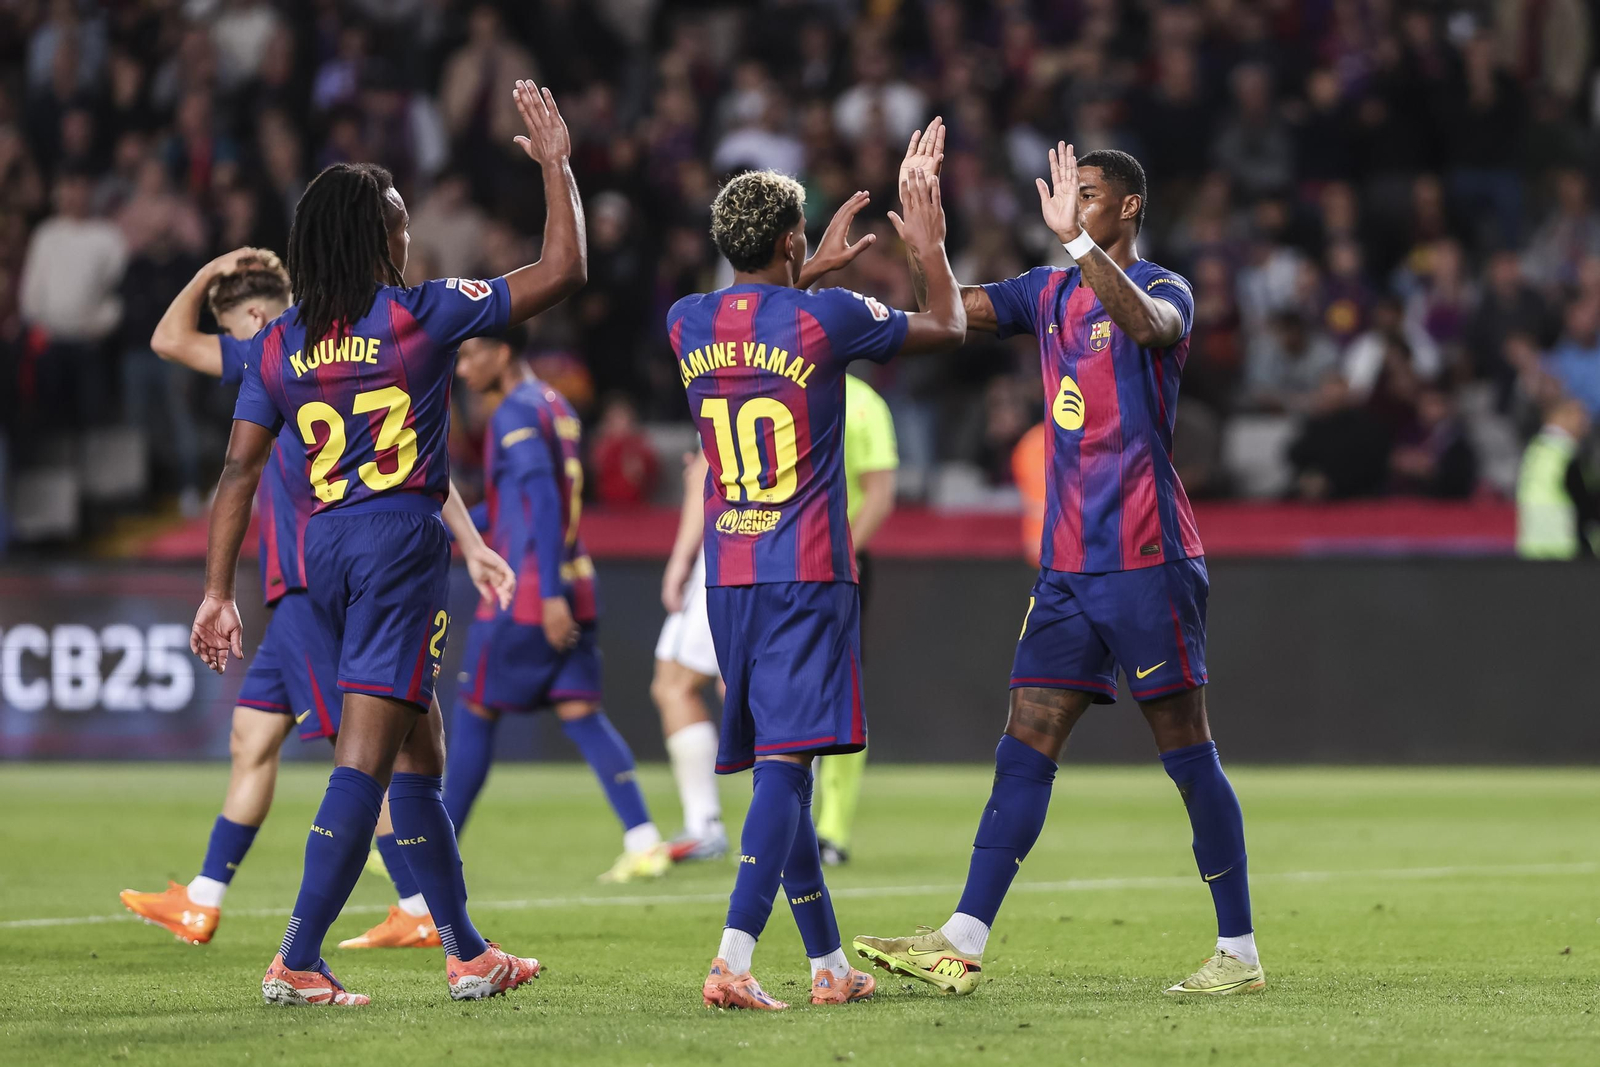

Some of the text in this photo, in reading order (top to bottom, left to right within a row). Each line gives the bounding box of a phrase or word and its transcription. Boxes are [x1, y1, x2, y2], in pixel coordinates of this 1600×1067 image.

[289, 336, 381, 378] KOUNDE
[743, 342, 816, 389] YAMAL
[297, 386, 418, 503] 23
[700, 397, 798, 503] 10
[0, 624, 195, 712] CB25
